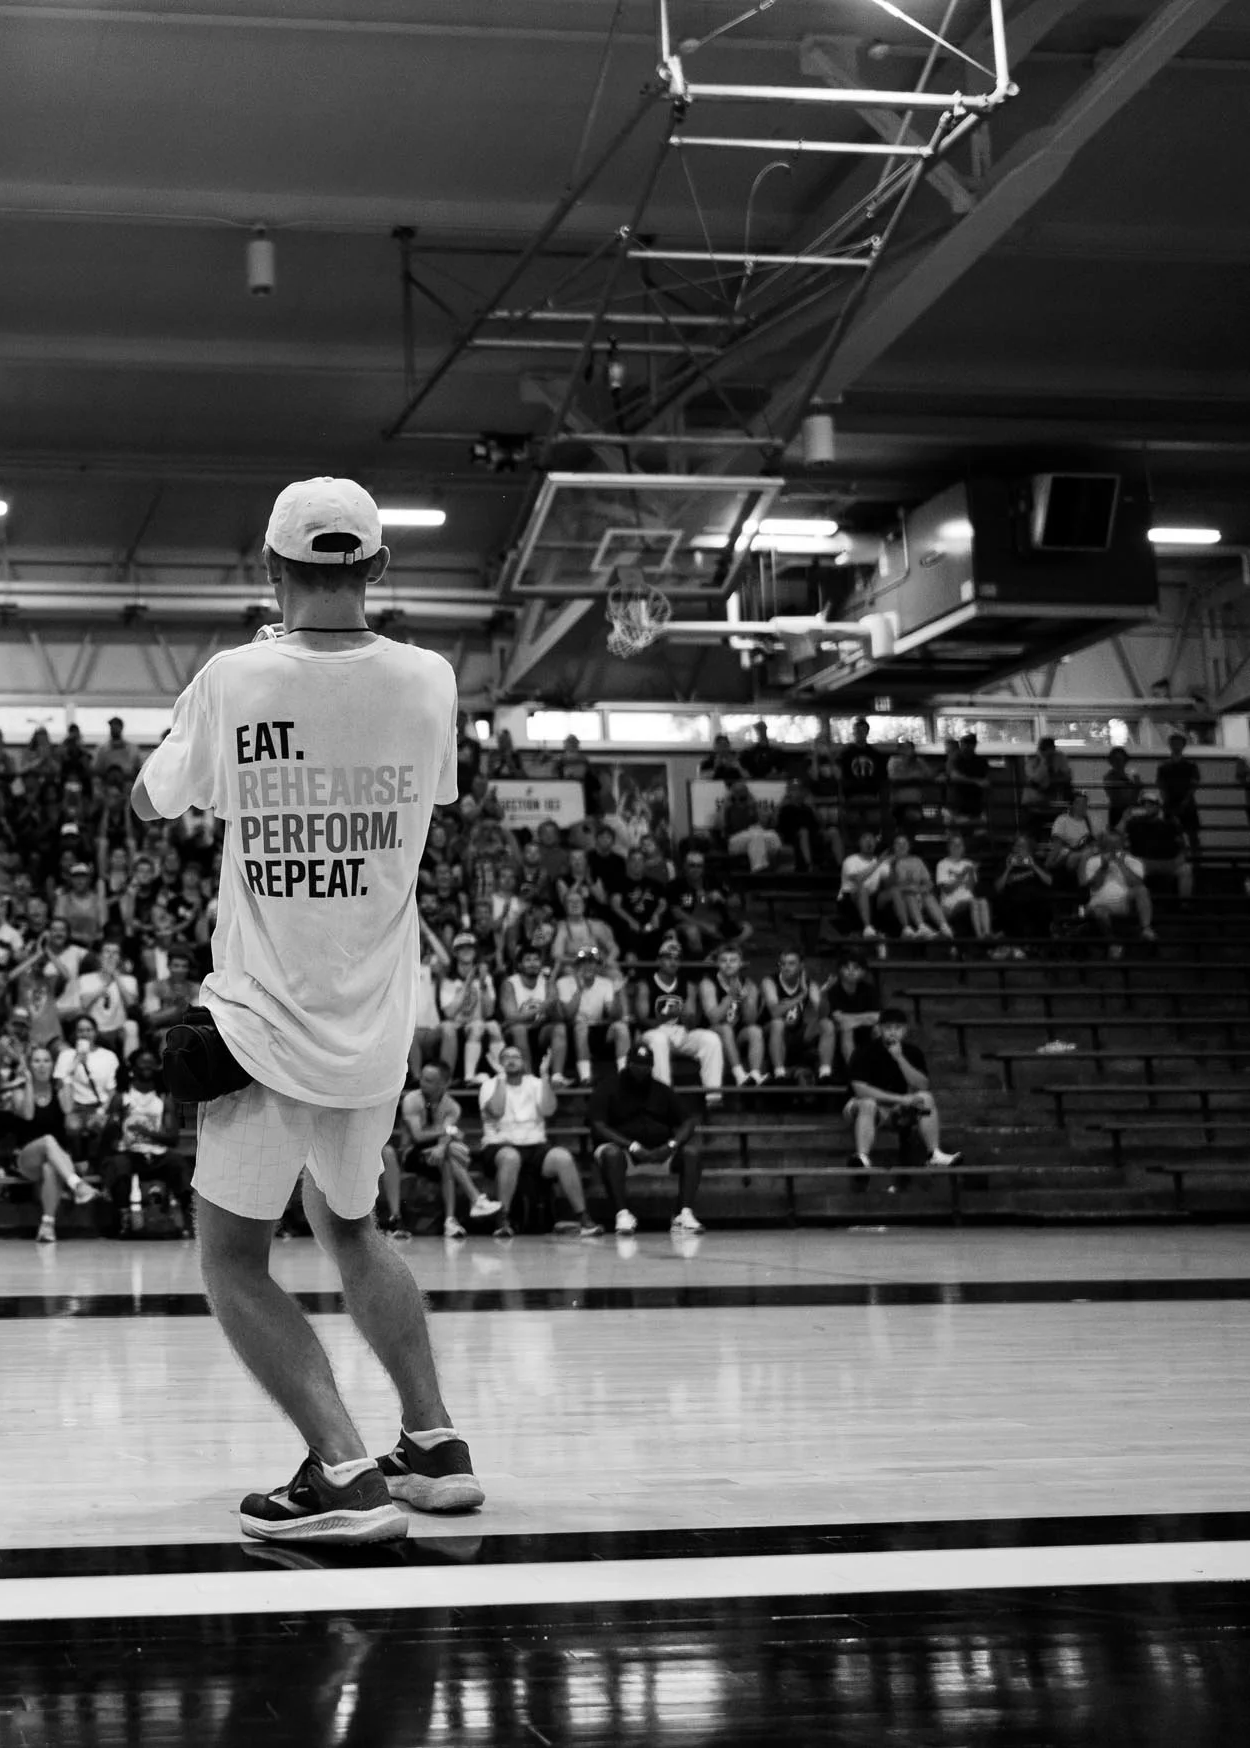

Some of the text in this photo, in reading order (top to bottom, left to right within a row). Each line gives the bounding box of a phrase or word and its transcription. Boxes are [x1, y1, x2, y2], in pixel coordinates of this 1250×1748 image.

[236, 721, 304, 765] EAT.
[238, 765, 419, 810] REHEARSE.
[240, 811, 403, 854] PERFORM.
[244, 857, 368, 898] REPEAT.
